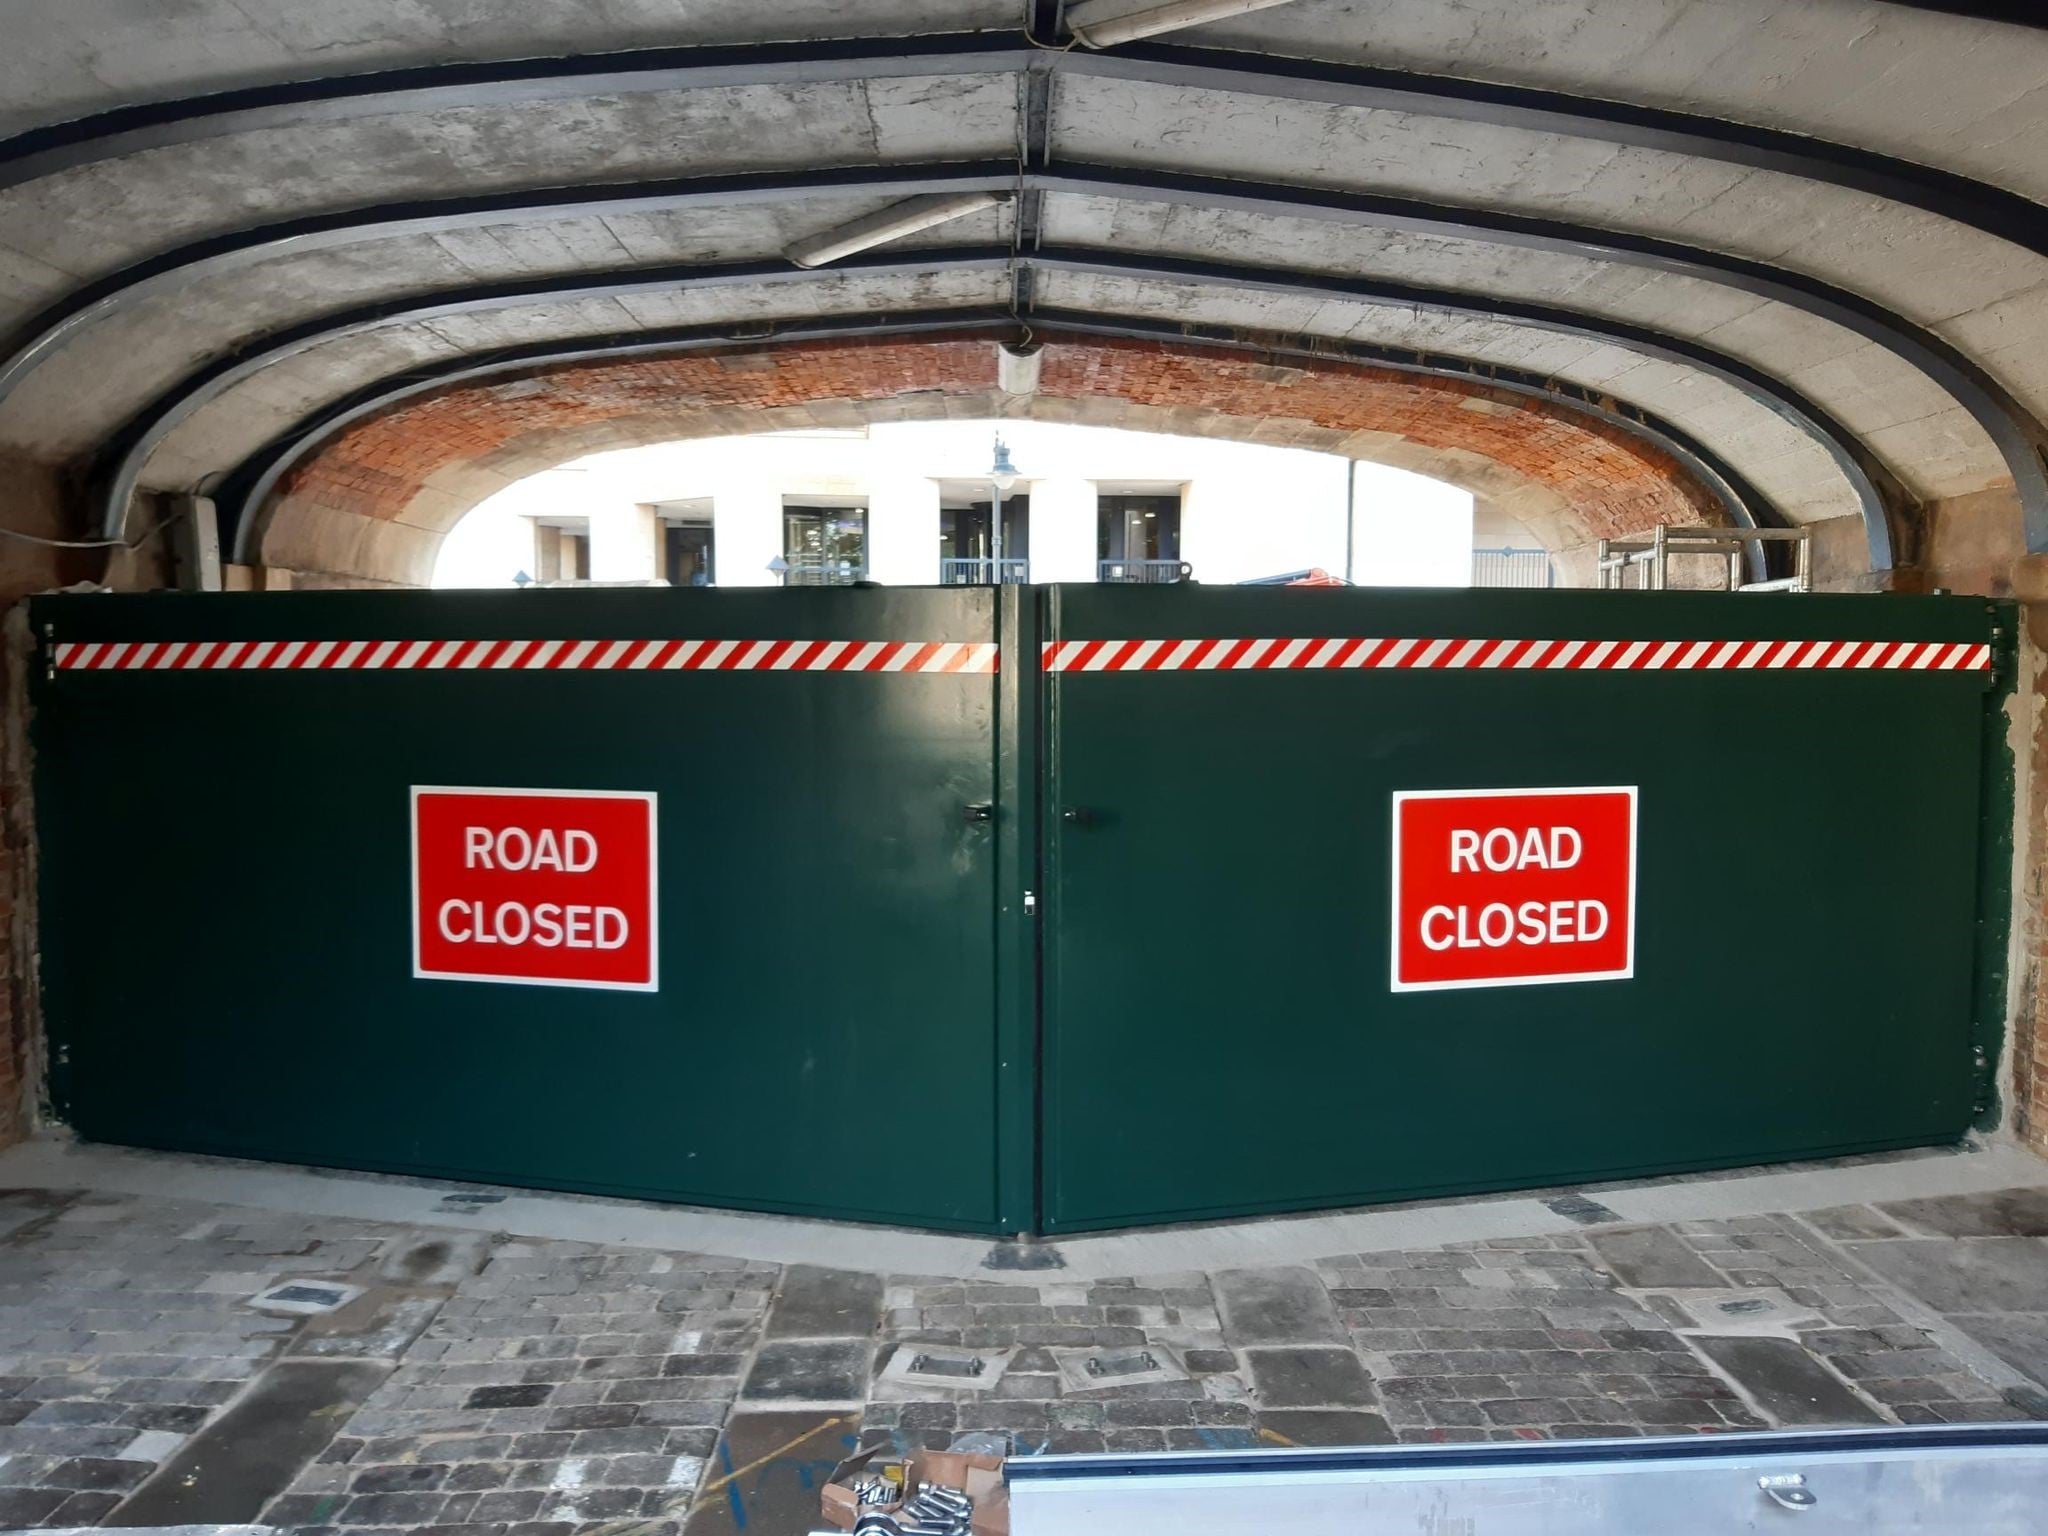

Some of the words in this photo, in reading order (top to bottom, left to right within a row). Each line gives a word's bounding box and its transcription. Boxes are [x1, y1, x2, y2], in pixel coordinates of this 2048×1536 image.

[464, 826, 598, 873] ROAD
[1450, 826, 1583, 874] ROAD
[438, 898, 629, 950] CLOSED
[1419, 898, 1610, 951] CLOSED
